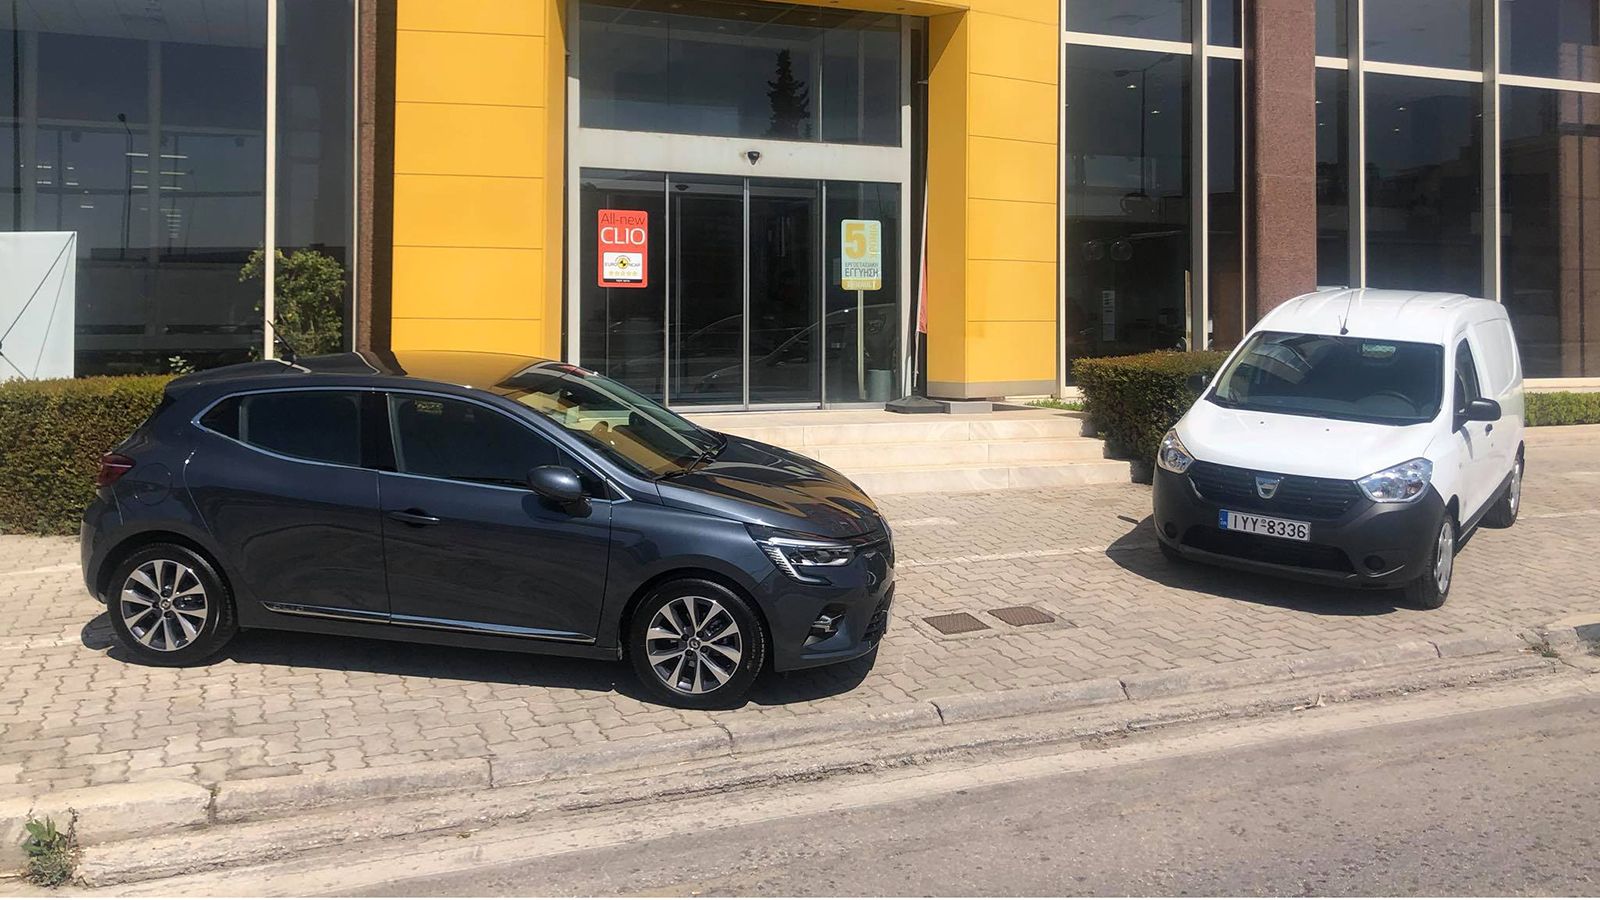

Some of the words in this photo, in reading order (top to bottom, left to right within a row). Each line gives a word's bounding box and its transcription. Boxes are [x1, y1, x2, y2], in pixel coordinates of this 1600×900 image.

[600, 213, 645, 225] All-new
[600, 227, 646, 245] CLIO
[846, 223, 865, 258] 5
[844, 268, 879, 278] ΕΓΓΥΗΣΗ
